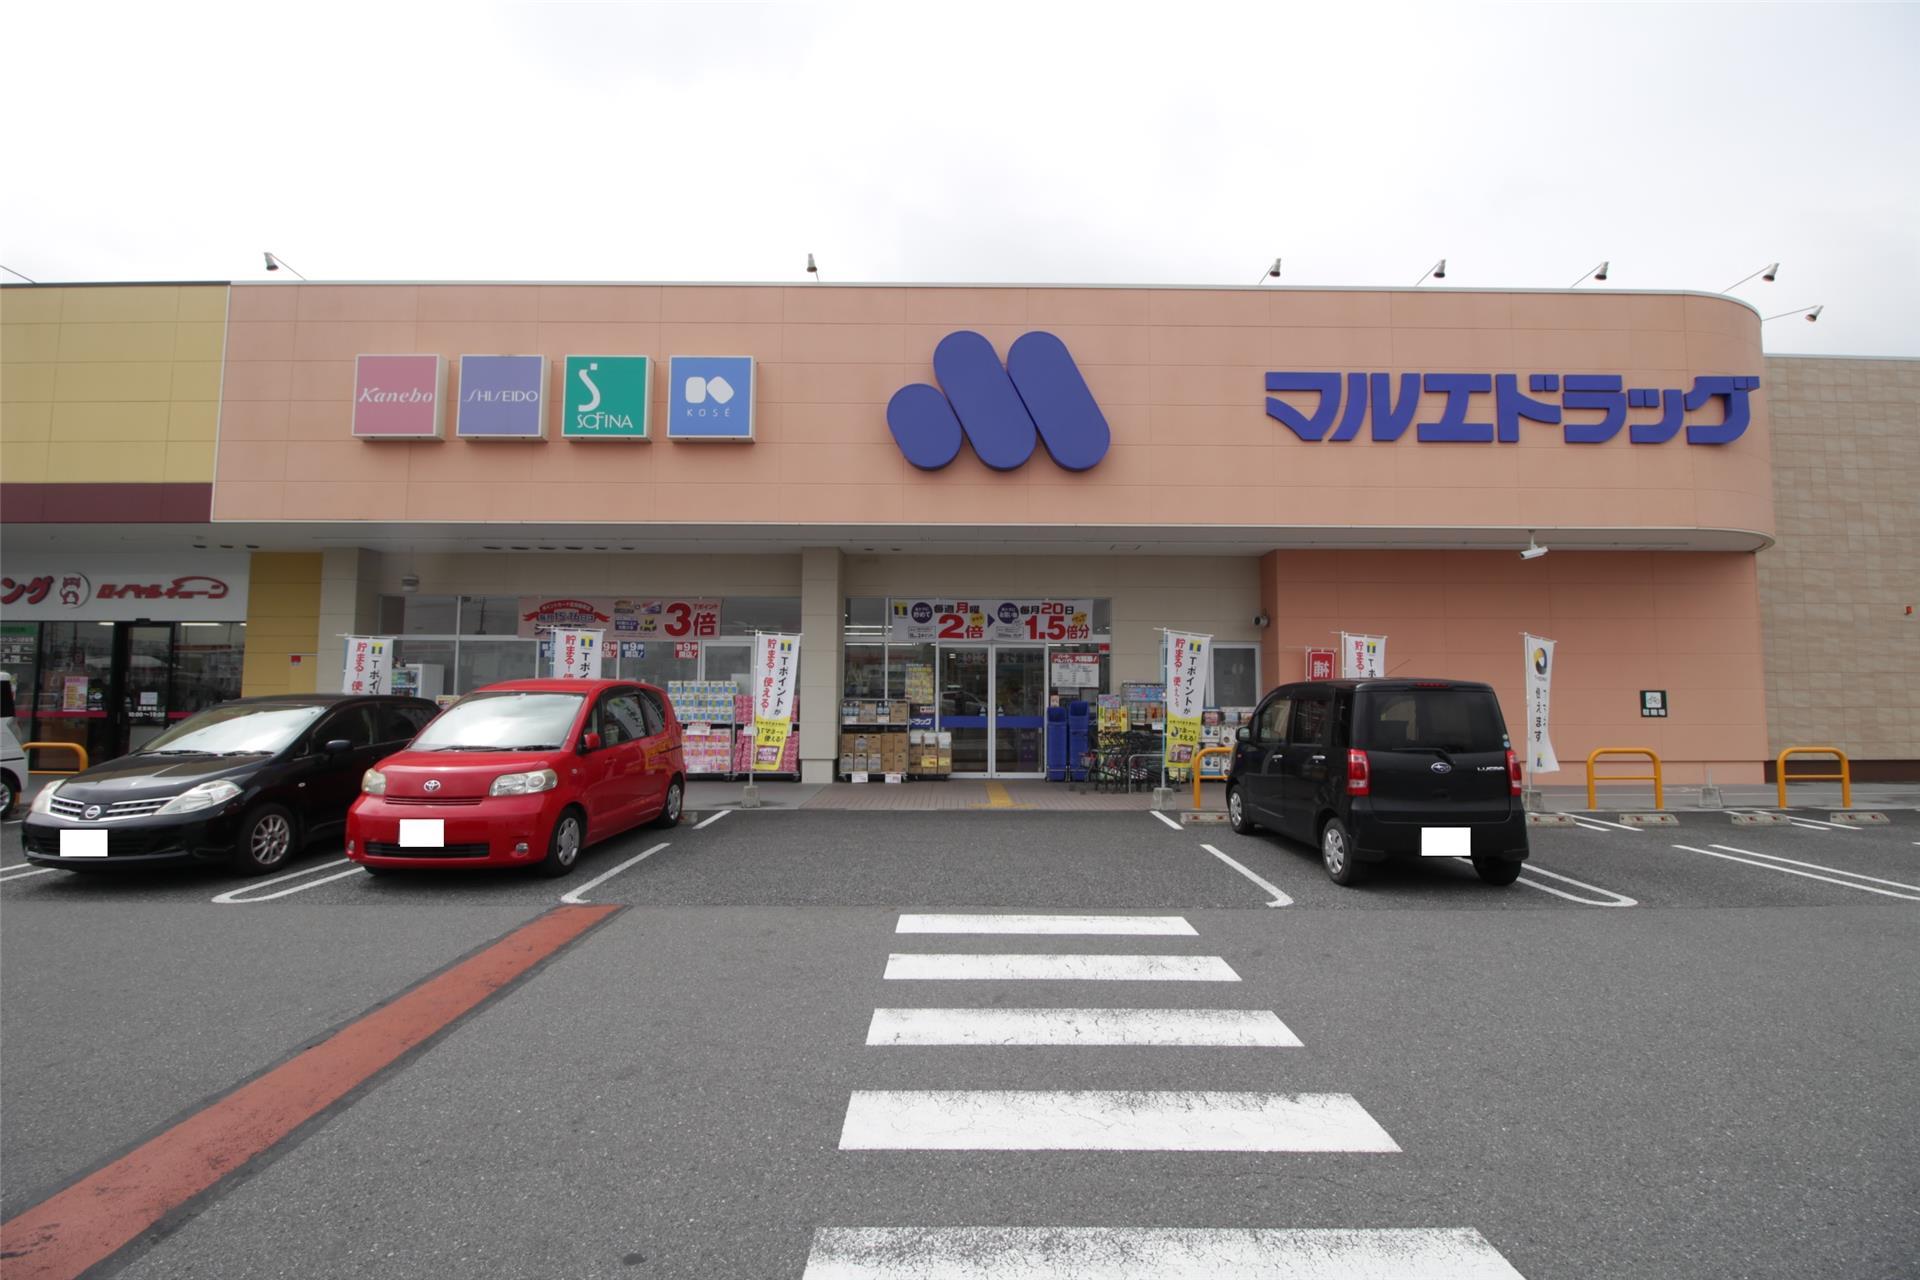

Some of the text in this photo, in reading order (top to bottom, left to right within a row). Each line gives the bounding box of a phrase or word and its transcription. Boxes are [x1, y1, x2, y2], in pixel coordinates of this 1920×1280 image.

[358, 386, 434, 404] Kanebo
[463, 388, 539, 403] SHISEIDO
[1265, 372, 1760, 445] マルエドラッグ
[576, 412, 633, 431] SOFINA
[0, 576, 54, 605] ング
